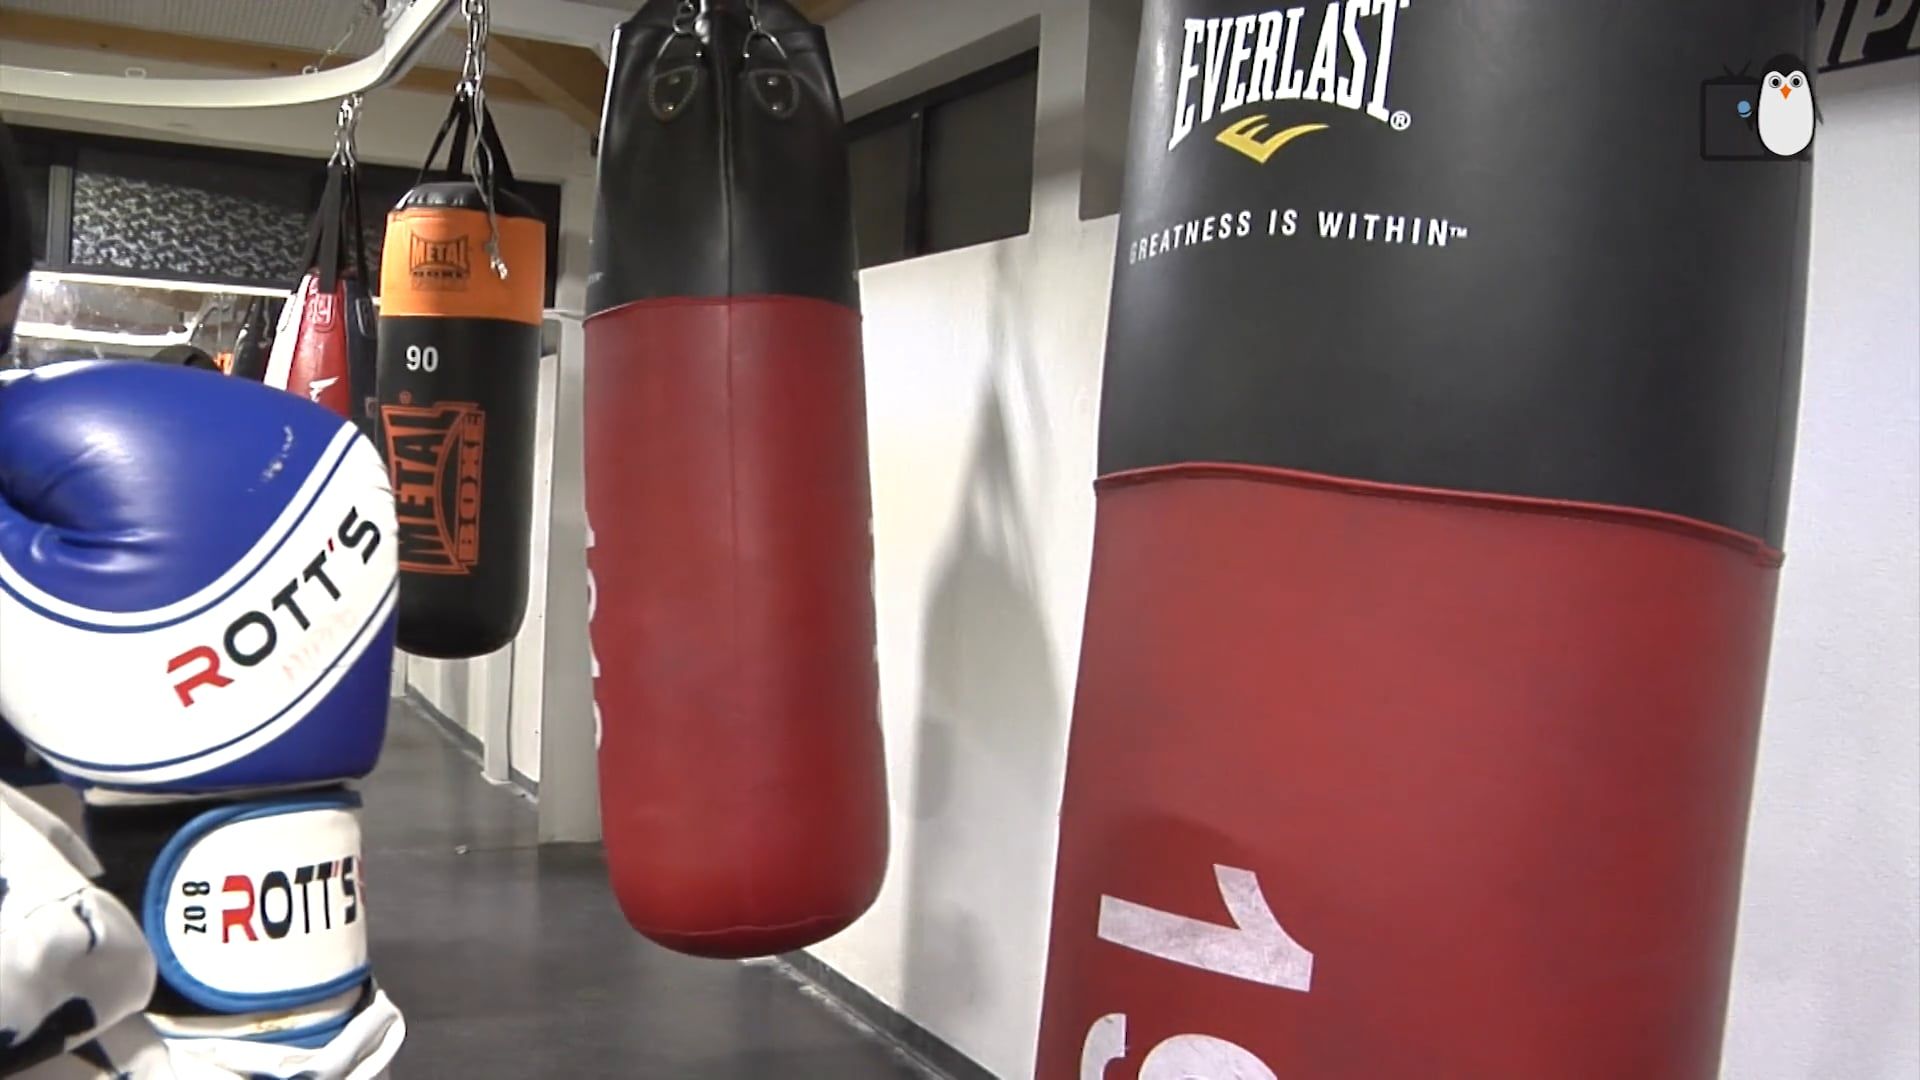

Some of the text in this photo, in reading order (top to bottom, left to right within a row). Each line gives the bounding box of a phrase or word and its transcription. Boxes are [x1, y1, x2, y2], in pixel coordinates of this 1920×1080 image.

[1129, 210, 1251, 264] GREATNESS
[1268, 208, 1298, 236] IS
[406, 345, 438, 372] 90
[458, 411, 485, 565] BOXE
[167, 505, 381, 707] ROTT'S
[182, 881, 210, 896] 8
[221, 855, 357, 943] ROTT'S
